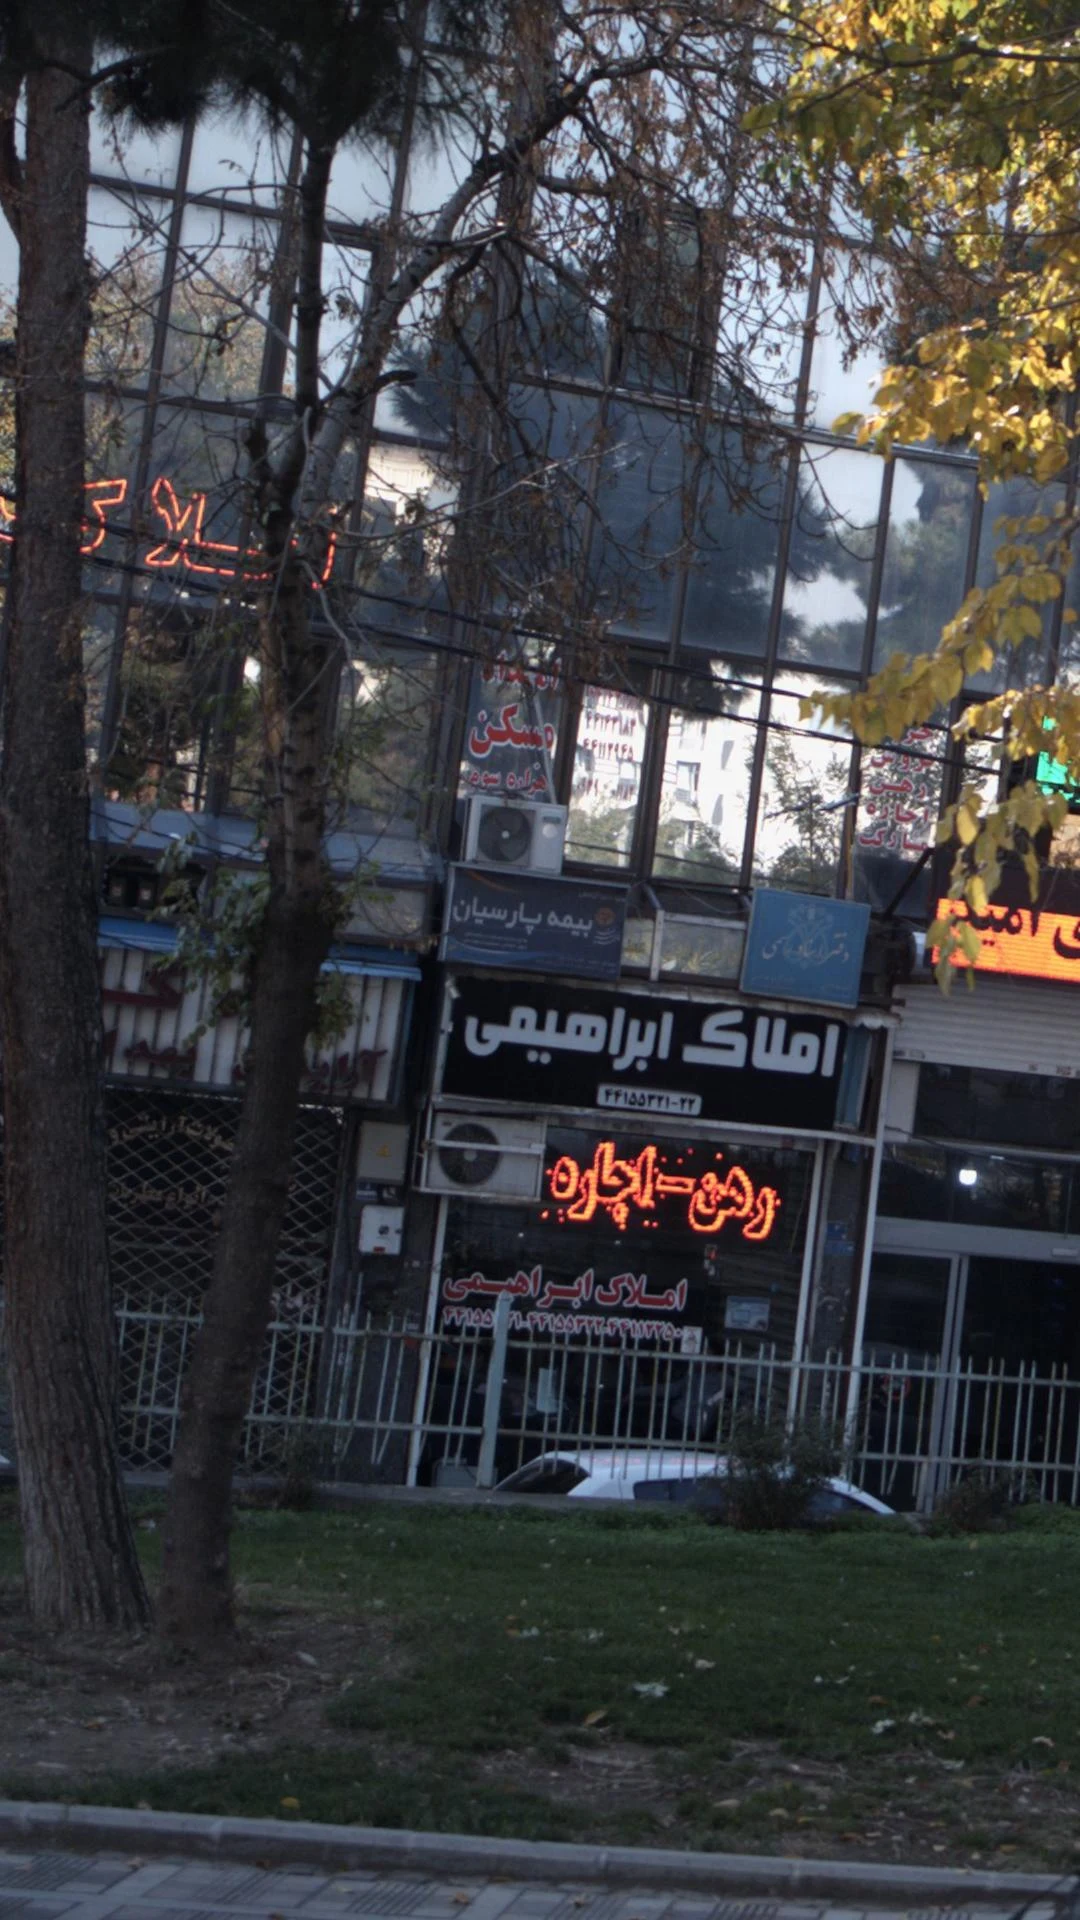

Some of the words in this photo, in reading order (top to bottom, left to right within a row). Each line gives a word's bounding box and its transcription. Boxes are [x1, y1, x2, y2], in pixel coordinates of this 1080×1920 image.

[468, 704, 556, 760] مسکن
[868, 777, 929, 801] رهن
[452, 896, 543, 936] پارسیان
[547, 909, 594, 939] بیمه
[464, 1006, 674, 1071] ابراهیمی
[682, 1010, 841, 1078] املاک
[442, 1264, 594, 1309] ابراهیمی
[596, 1273, 688, 1312] املاک
